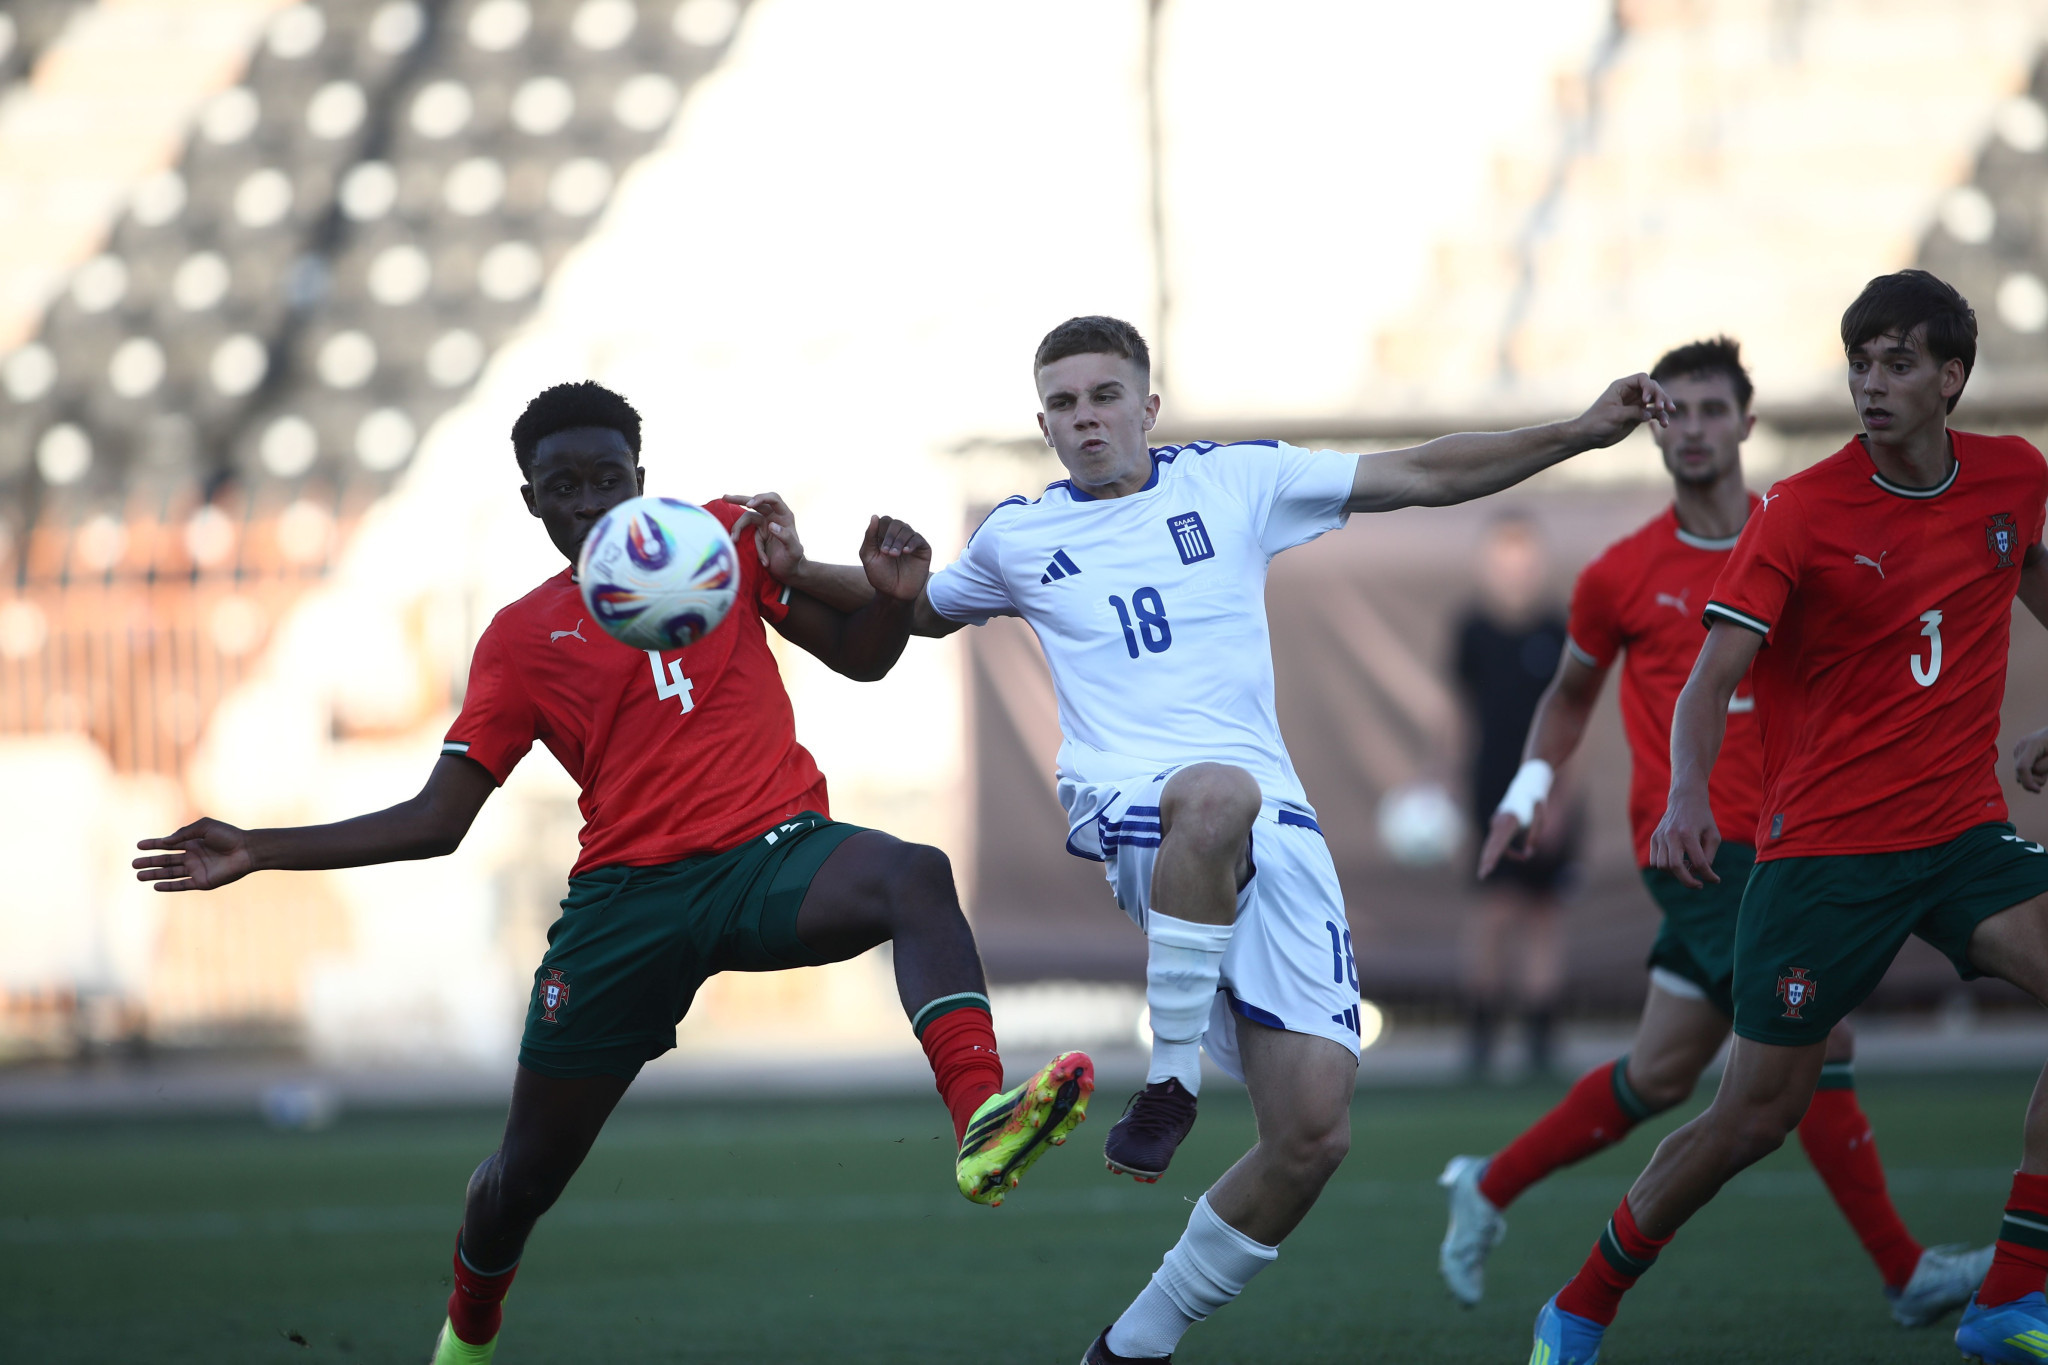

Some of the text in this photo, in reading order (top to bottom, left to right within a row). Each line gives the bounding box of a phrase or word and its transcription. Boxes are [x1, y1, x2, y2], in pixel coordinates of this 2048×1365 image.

[1109, 586, 1172, 659] 18
[1911, 610, 1942, 687] 3
[642, 650, 696, 715] 4
[1326, 920, 1359, 993] 18
